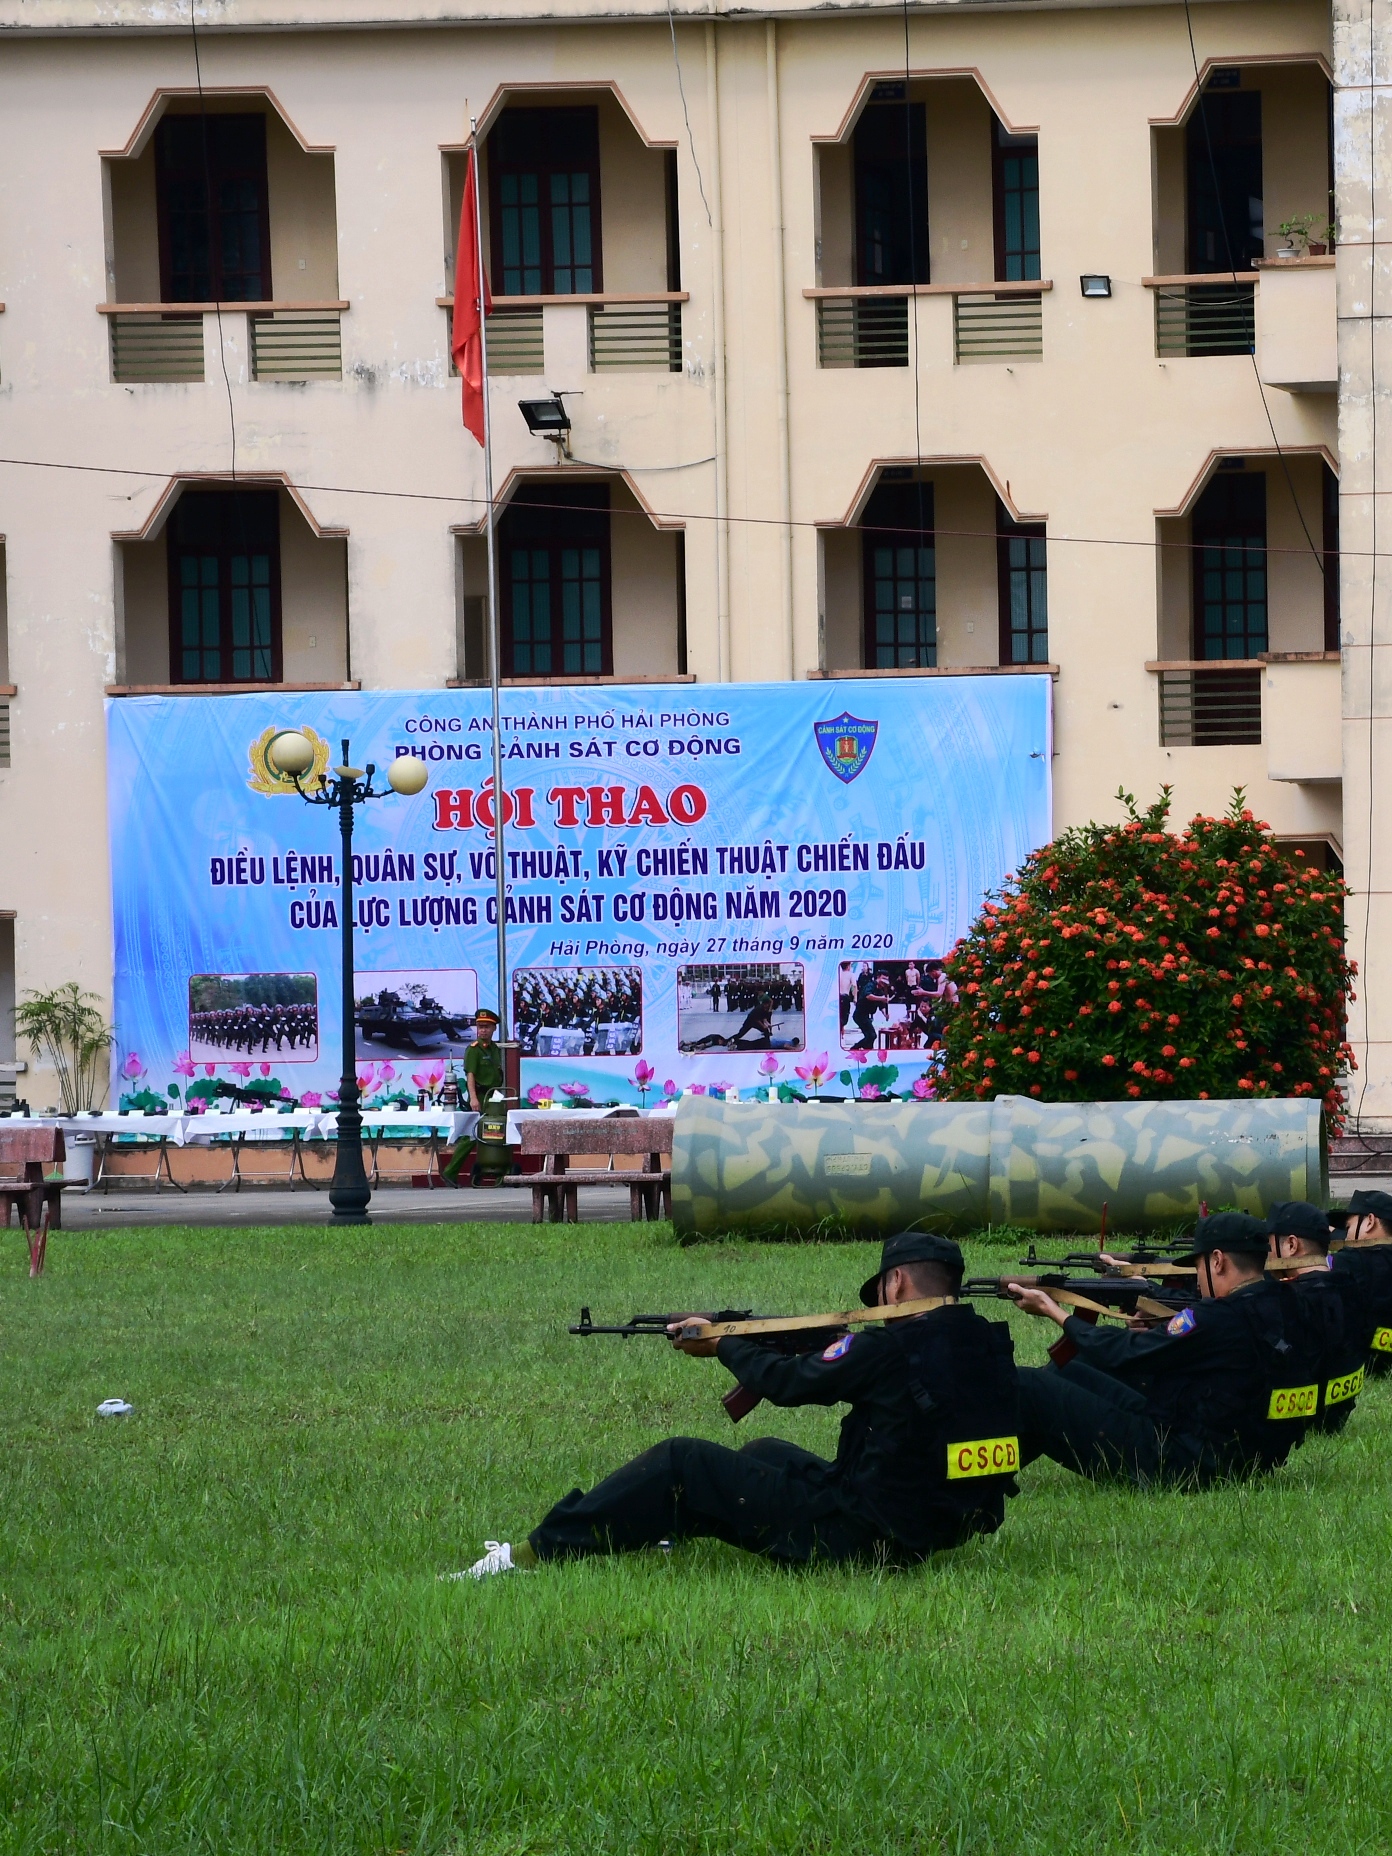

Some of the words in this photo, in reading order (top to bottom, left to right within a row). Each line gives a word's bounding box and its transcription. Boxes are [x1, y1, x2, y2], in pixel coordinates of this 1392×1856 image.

[405, 715, 462, 733] CÔNG
[468, 717, 494, 732] AN
[501, 712, 567, 731] THÀNH
[575, 709, 615, 729] PHỐ
[622, 709, 653, 729] HẢI
[660, 709, 730, 728] PHÒNG
[395, 741, 482, 761] PHÒNG
[569, 737, 617, 758] SÁT
[625, 739, 660, 757] CƠ
[668, 735, 741, 760] ĐỘNG
[548, 784, 707, 827] THAO
[210, 847, 265, 885] ĐIỀU
[272, 850, 340, 890] LỆNH,
[351, 848, 415, 885] QUÂN
[423, 849, 462, 886] SỰ,
[469, 846, 496, 880] VÕ
[508, 844, 590, 885] THUẬT,
[598, 844, 628, 877] KỸ
[636, 837, 708, 877] CHIẾN
[716, 840, 789, 880] THUẬT
[797, 832, 869, 872] CHIẾN
[876, 832, 925, 871] ĐẤU
[290, 889, 338, 929] CỦA
[351, 896, 390, 934] ỰC
[399, 895, 477, 932] LƯỢNG
[486, 884, 552, 924] CẢNH
[560, 889, 605, 923] SÁT
[613, 892, 645, 922] CƠ
[652, 887, 717, 927] ĐỘNG
[726, 885, 780, 919] NĂM
[788, 889, 847, 918] 2020
[550, 940, 580, 956] Hải
[585, 939, 649, 958] Phòng,
[656, 940, 701, 958] ngày
[706, 938, 727, 953] 27
[733, 937, 783, 955] tháng
[789, 936, 800, 951] 9
[806, 935, 844, 950] năm
[851, 933, 894, 949] 2020
[723, 1324, 737, 1333] 10
